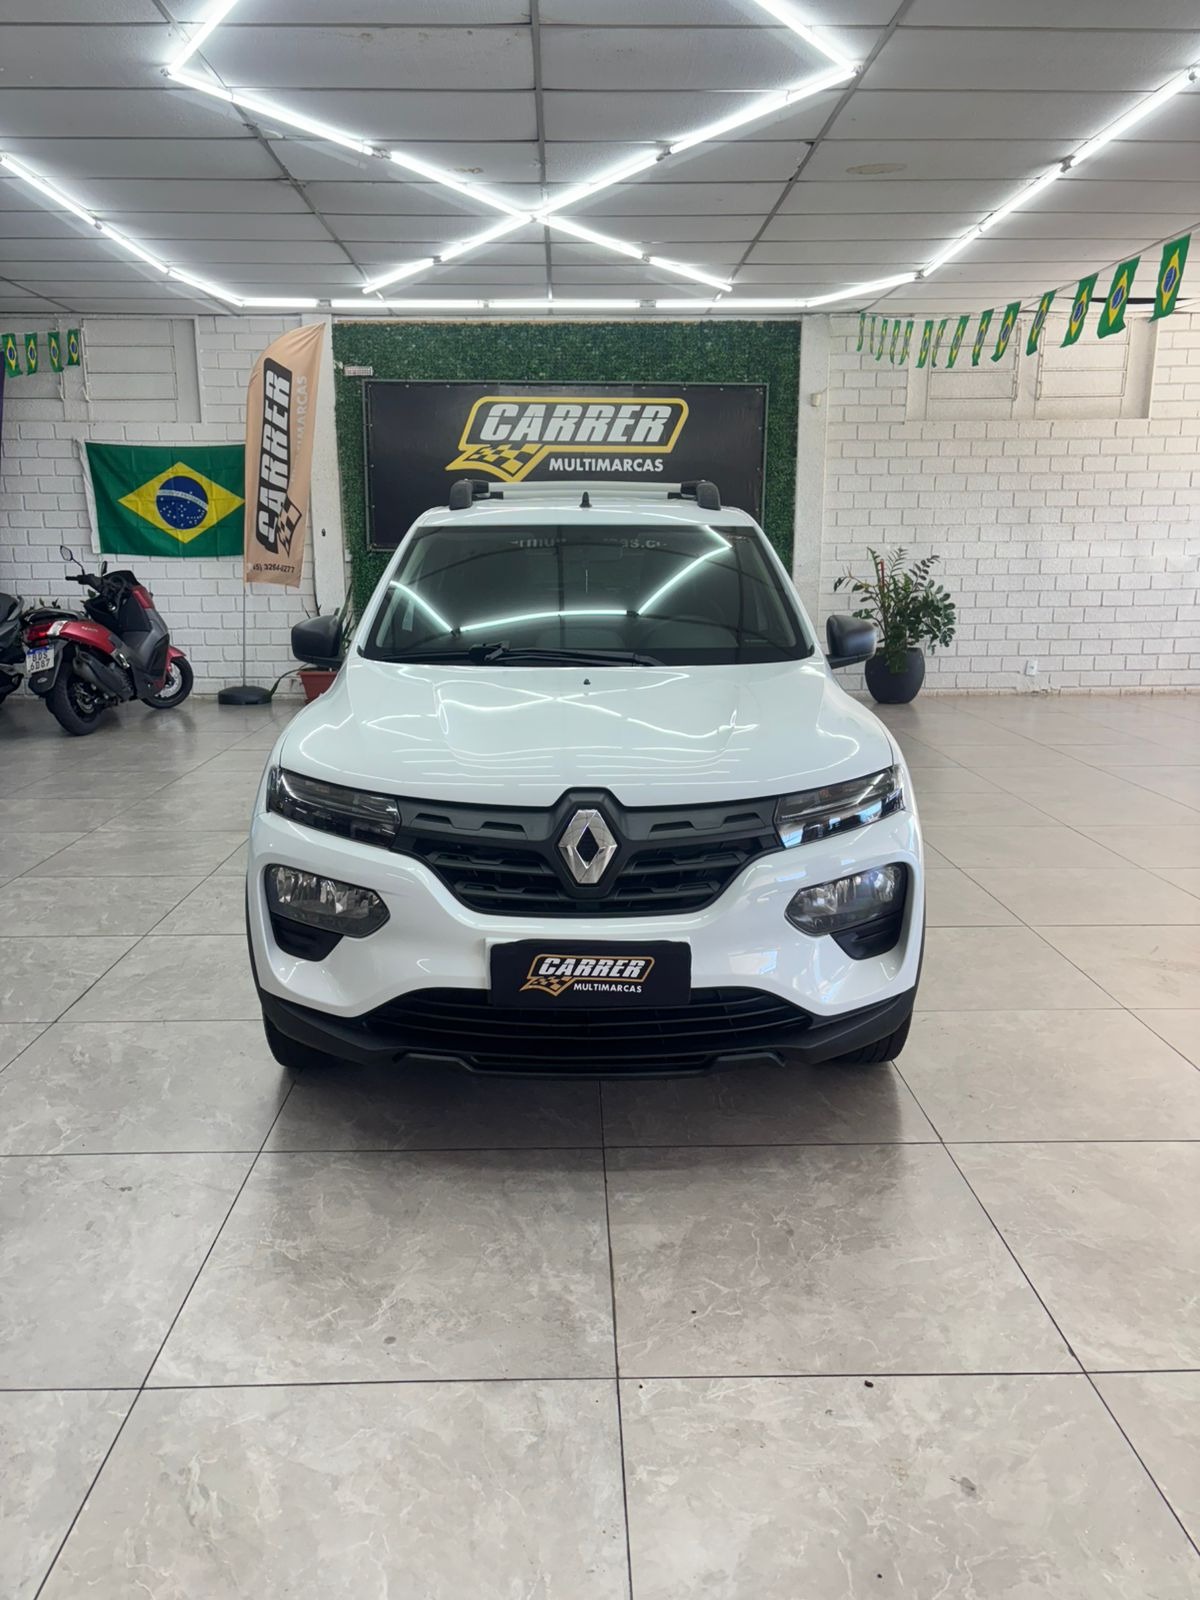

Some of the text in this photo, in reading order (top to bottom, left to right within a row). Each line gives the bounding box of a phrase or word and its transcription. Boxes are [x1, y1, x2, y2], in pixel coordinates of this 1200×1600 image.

[479, 403, 673, 443] CARRER
[258, 370, 291, 544] CARRER
[549, 457, 664, 473] MULTIMARCAS
[538, 957, 646, 978] CARRER
[573, 983, 642, 993] MULTIMARCAS
